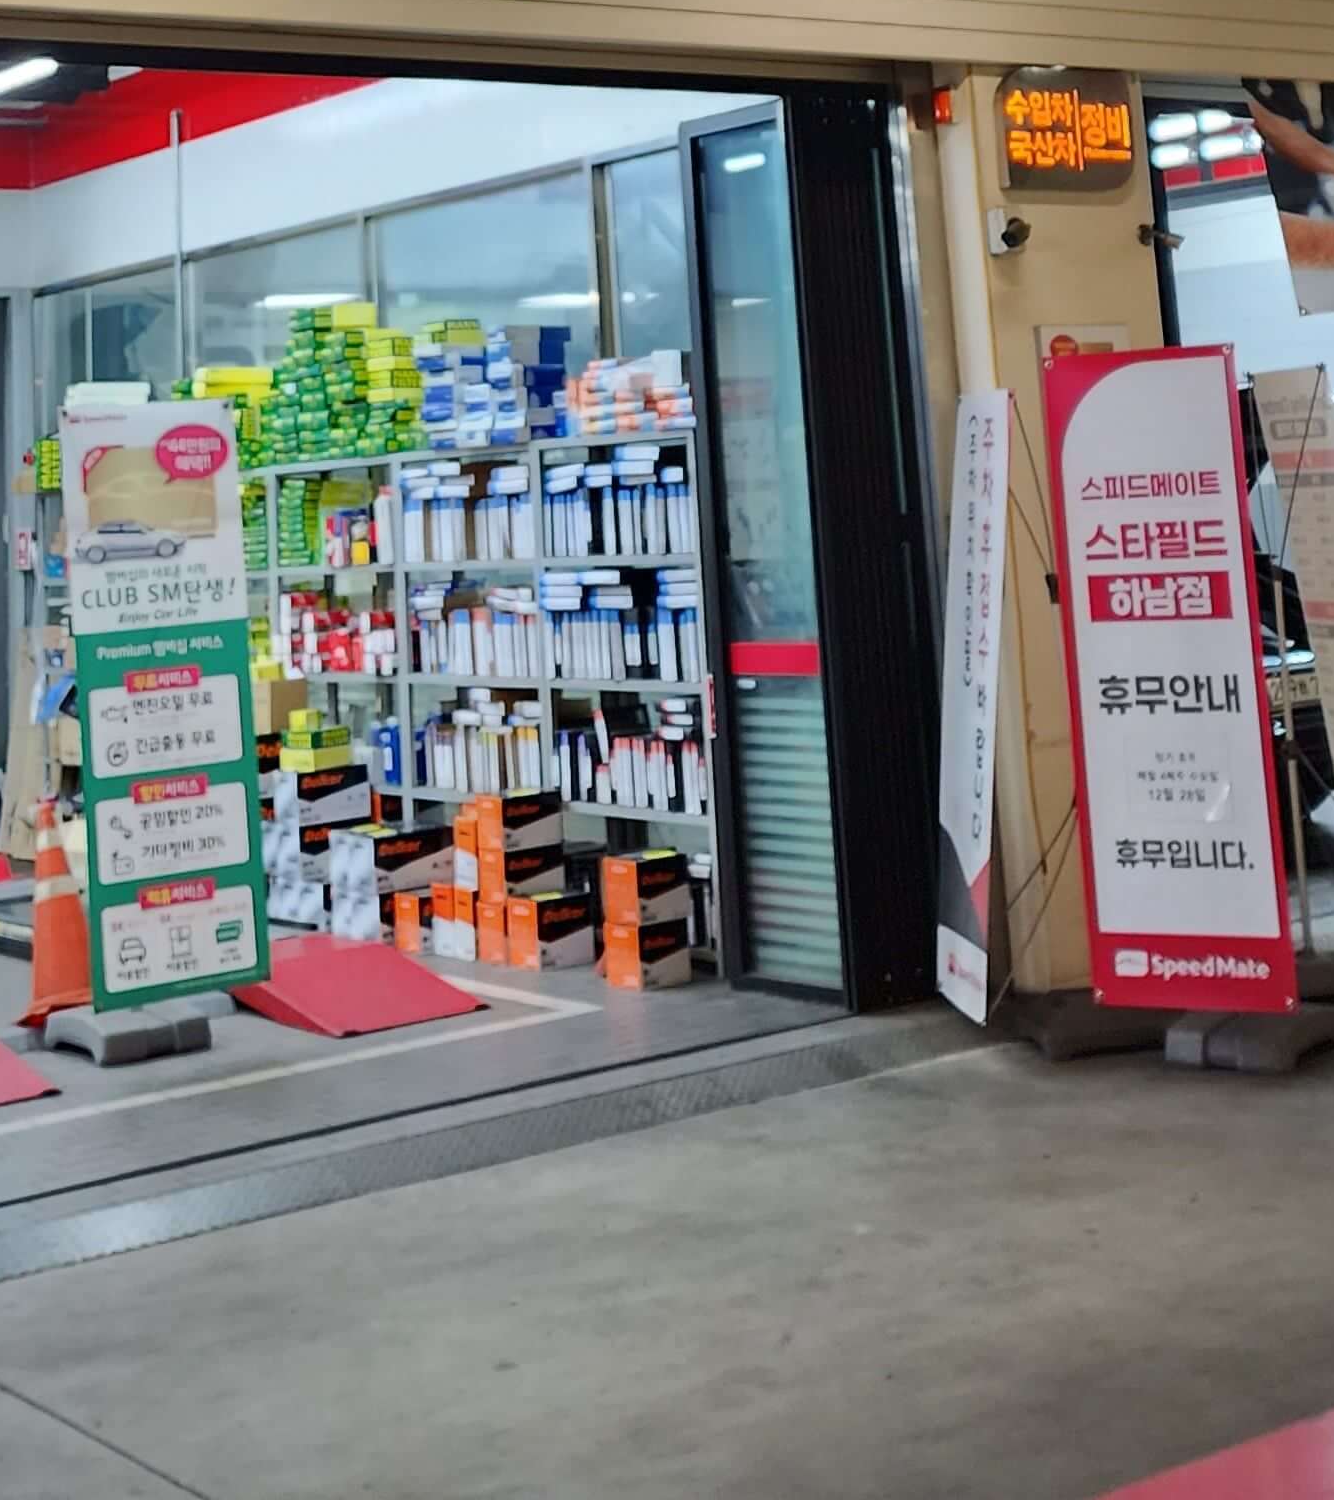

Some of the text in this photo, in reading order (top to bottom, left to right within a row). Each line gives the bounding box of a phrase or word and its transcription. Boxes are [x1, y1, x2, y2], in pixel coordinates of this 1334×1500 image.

[1006, 90, 1131, 148] 수입차 정비
[1009, 130, 1077, 167] 국산차
[1081, 470, 1222, 501] 스피드메이트
[1085, 519, 1228, 561] 스타필드
[82, 585, 139, 609] CLUB
[1108, 576, 1213, 617] 하남점
[1099, 674, 1241, 715] 휴무안내
[1116, 838, 1255, 870] 휴무입니다.
[1151, 952, 1271, 980] SpeedMate
